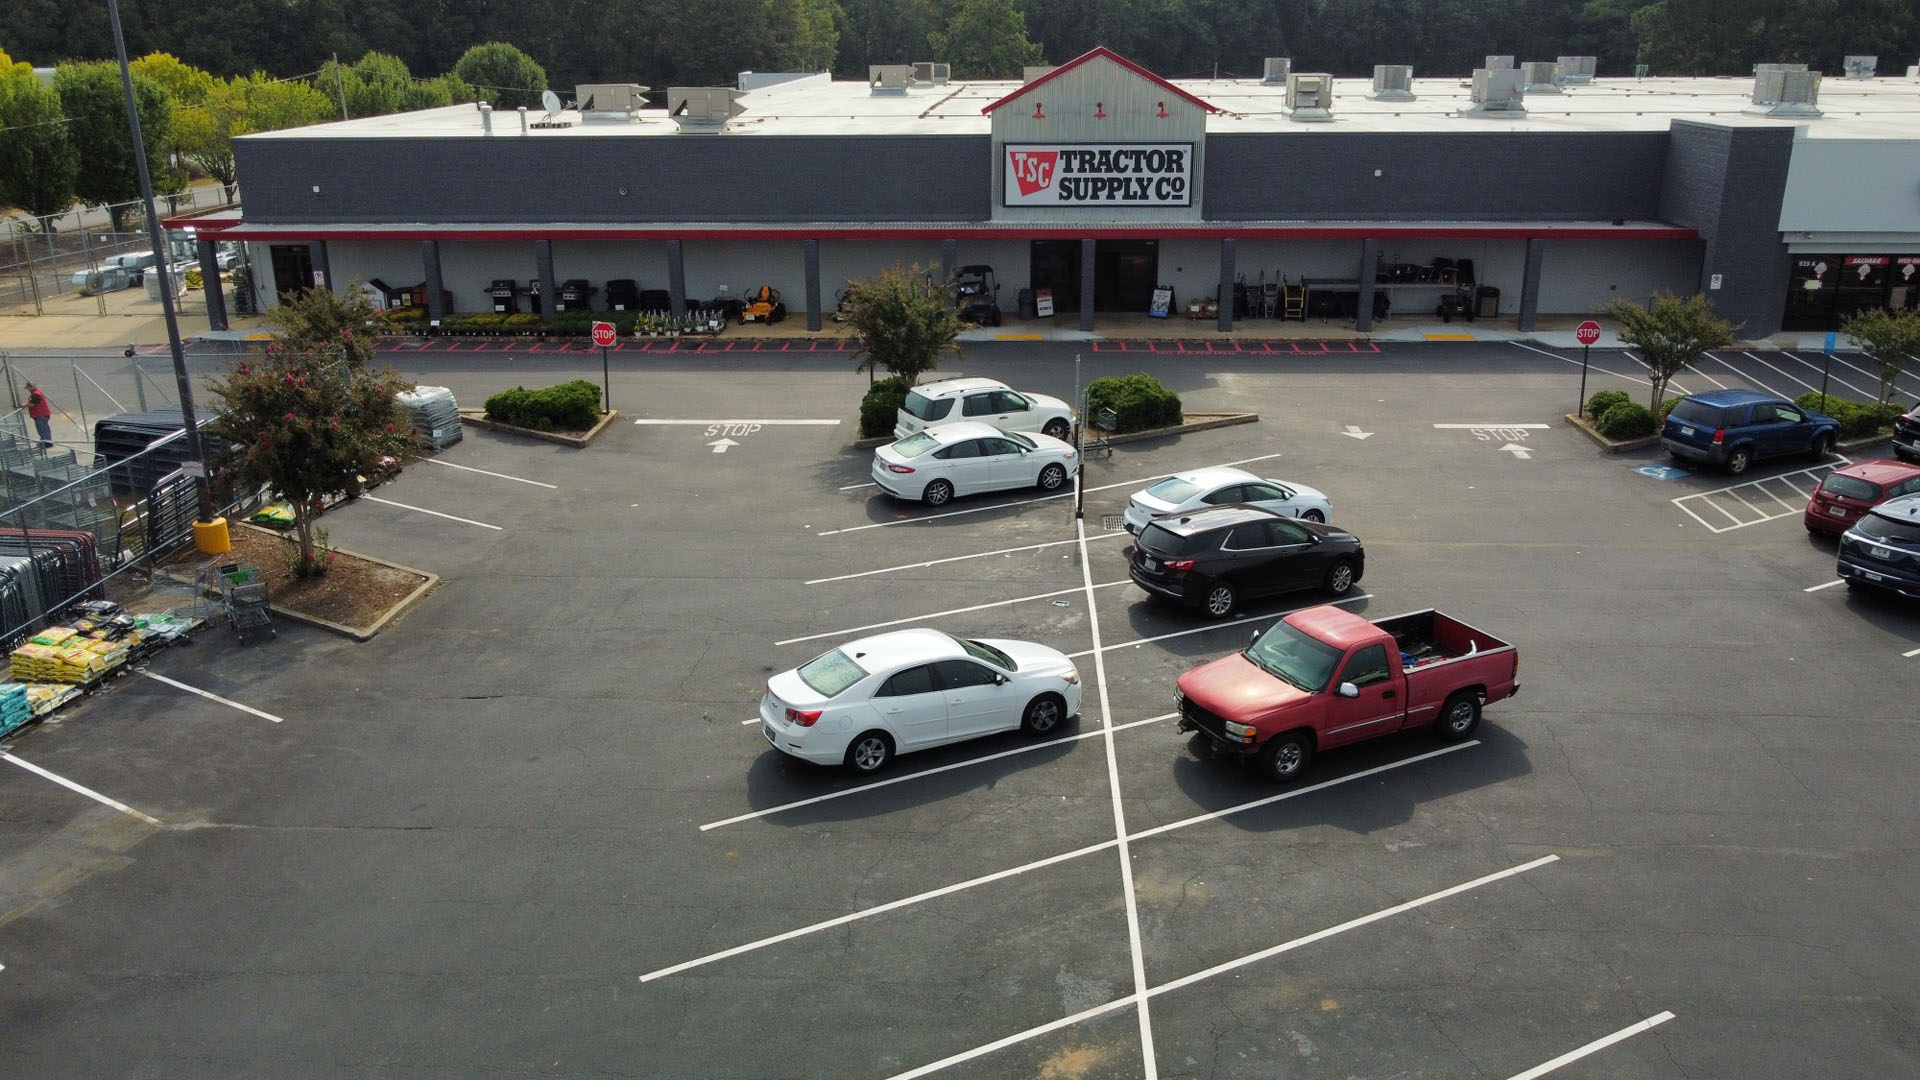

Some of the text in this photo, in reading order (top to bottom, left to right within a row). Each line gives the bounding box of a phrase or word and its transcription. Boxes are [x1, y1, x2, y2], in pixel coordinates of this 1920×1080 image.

[1059, 149, 1185, 174] TRACTOR
[1015, 153, 1050, 188] TSC
[1058, 177, 1154, 201] SUPPLY
[593, 329, 615, 339] STOP
[1577, 328, 1600, 338] STOP
[703, 423, 762, 437] STOP
[1470, 428, 1530, 441] STOP
